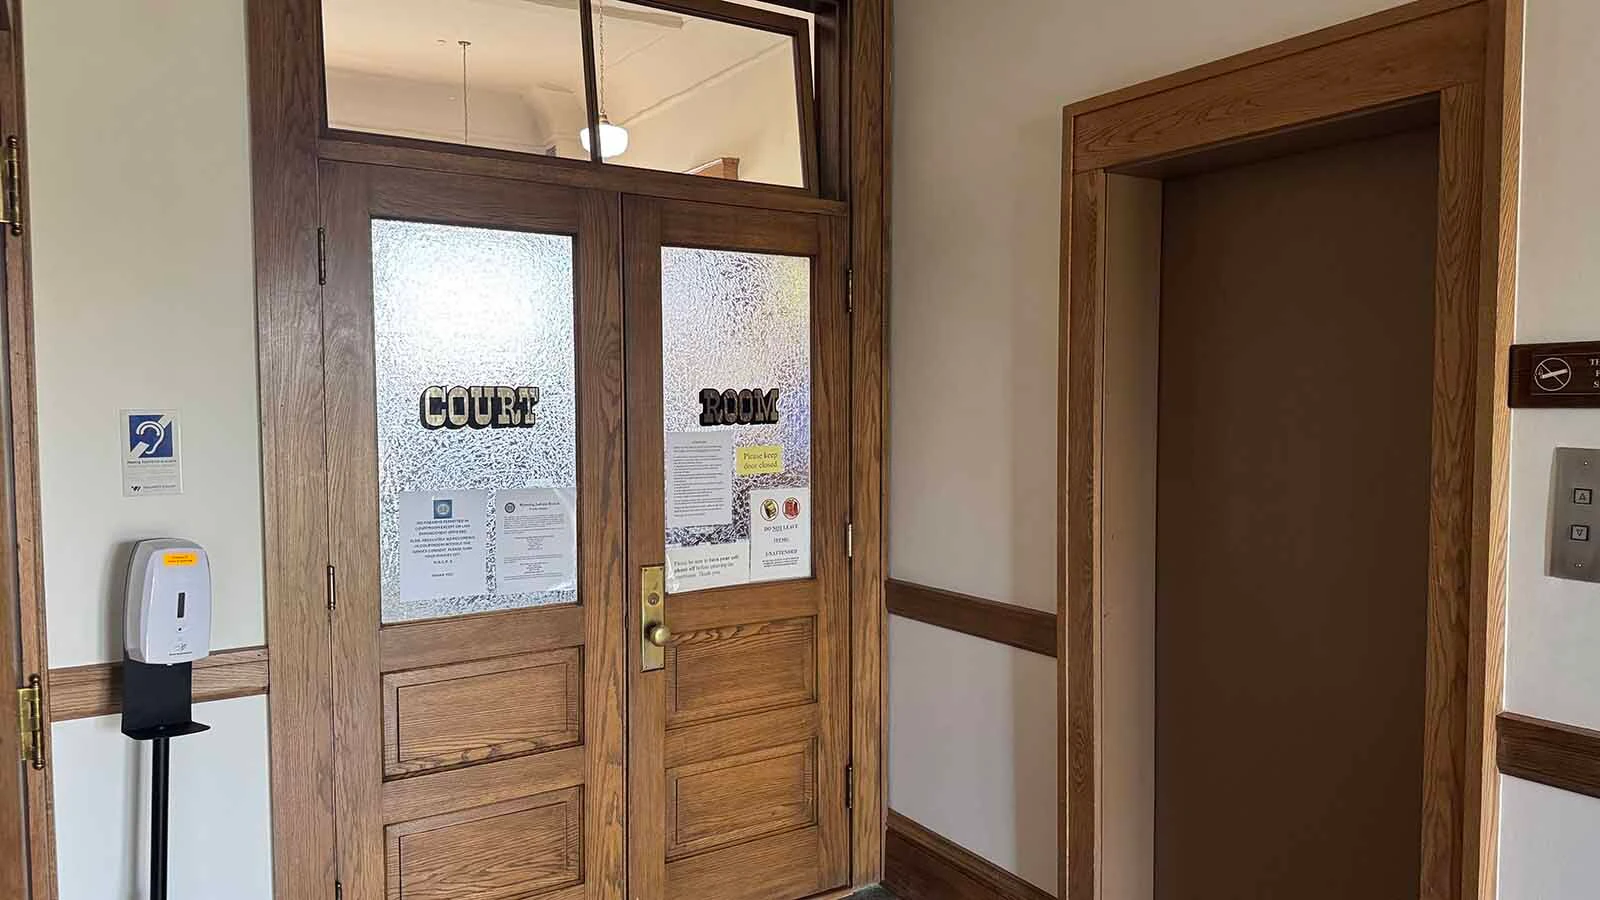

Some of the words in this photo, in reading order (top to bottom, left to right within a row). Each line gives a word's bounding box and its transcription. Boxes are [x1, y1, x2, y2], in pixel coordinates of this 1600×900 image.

[420, 385, 540, 430] COURT
[699, 388, 779, 426] ROOM
[743, 452, 762, 460] Please
[764, 450, 778, 460] keep
